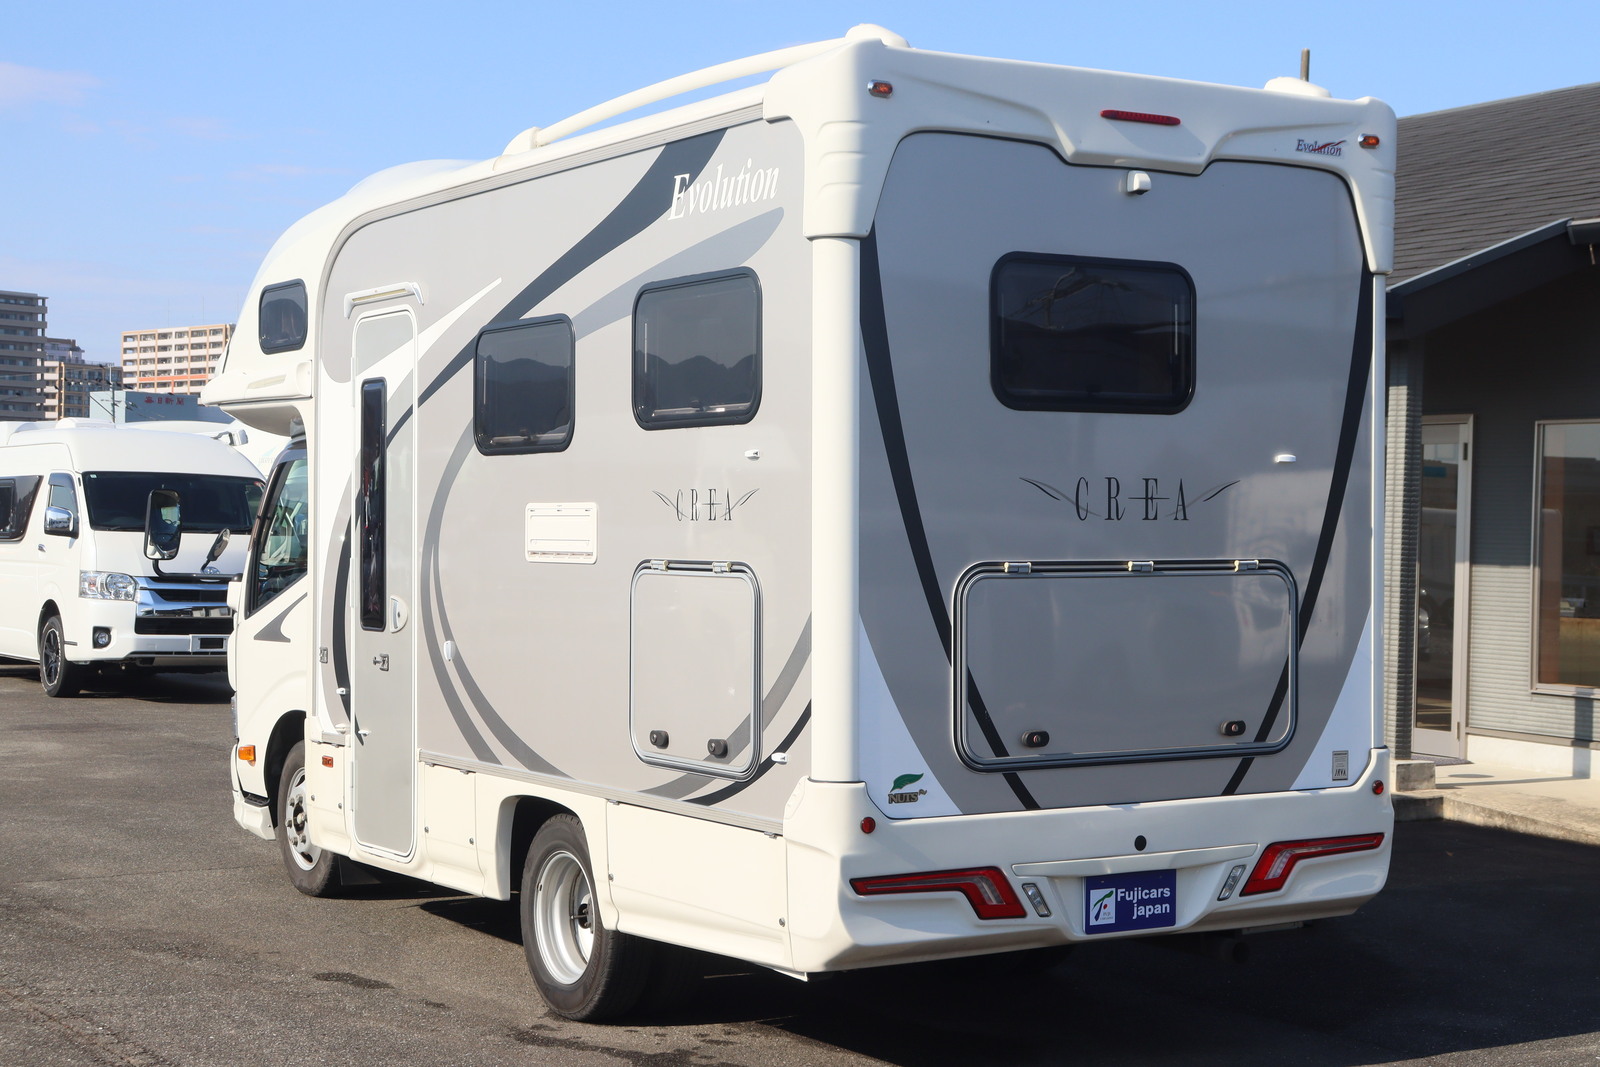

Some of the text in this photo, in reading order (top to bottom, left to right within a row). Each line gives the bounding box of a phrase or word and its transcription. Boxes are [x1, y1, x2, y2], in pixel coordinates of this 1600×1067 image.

[1295, 138, 1342, 157] Evolution
[667, 157, 780, 221] Evolution
[675, 488, 733, 522] CREA
[1075, 476, 1190, 521] CREA
[888, 791, 919, 804] NUTS
[1117, 887, 1171, 903] Fujicars
[1132, 903, 1170, 920] japan
